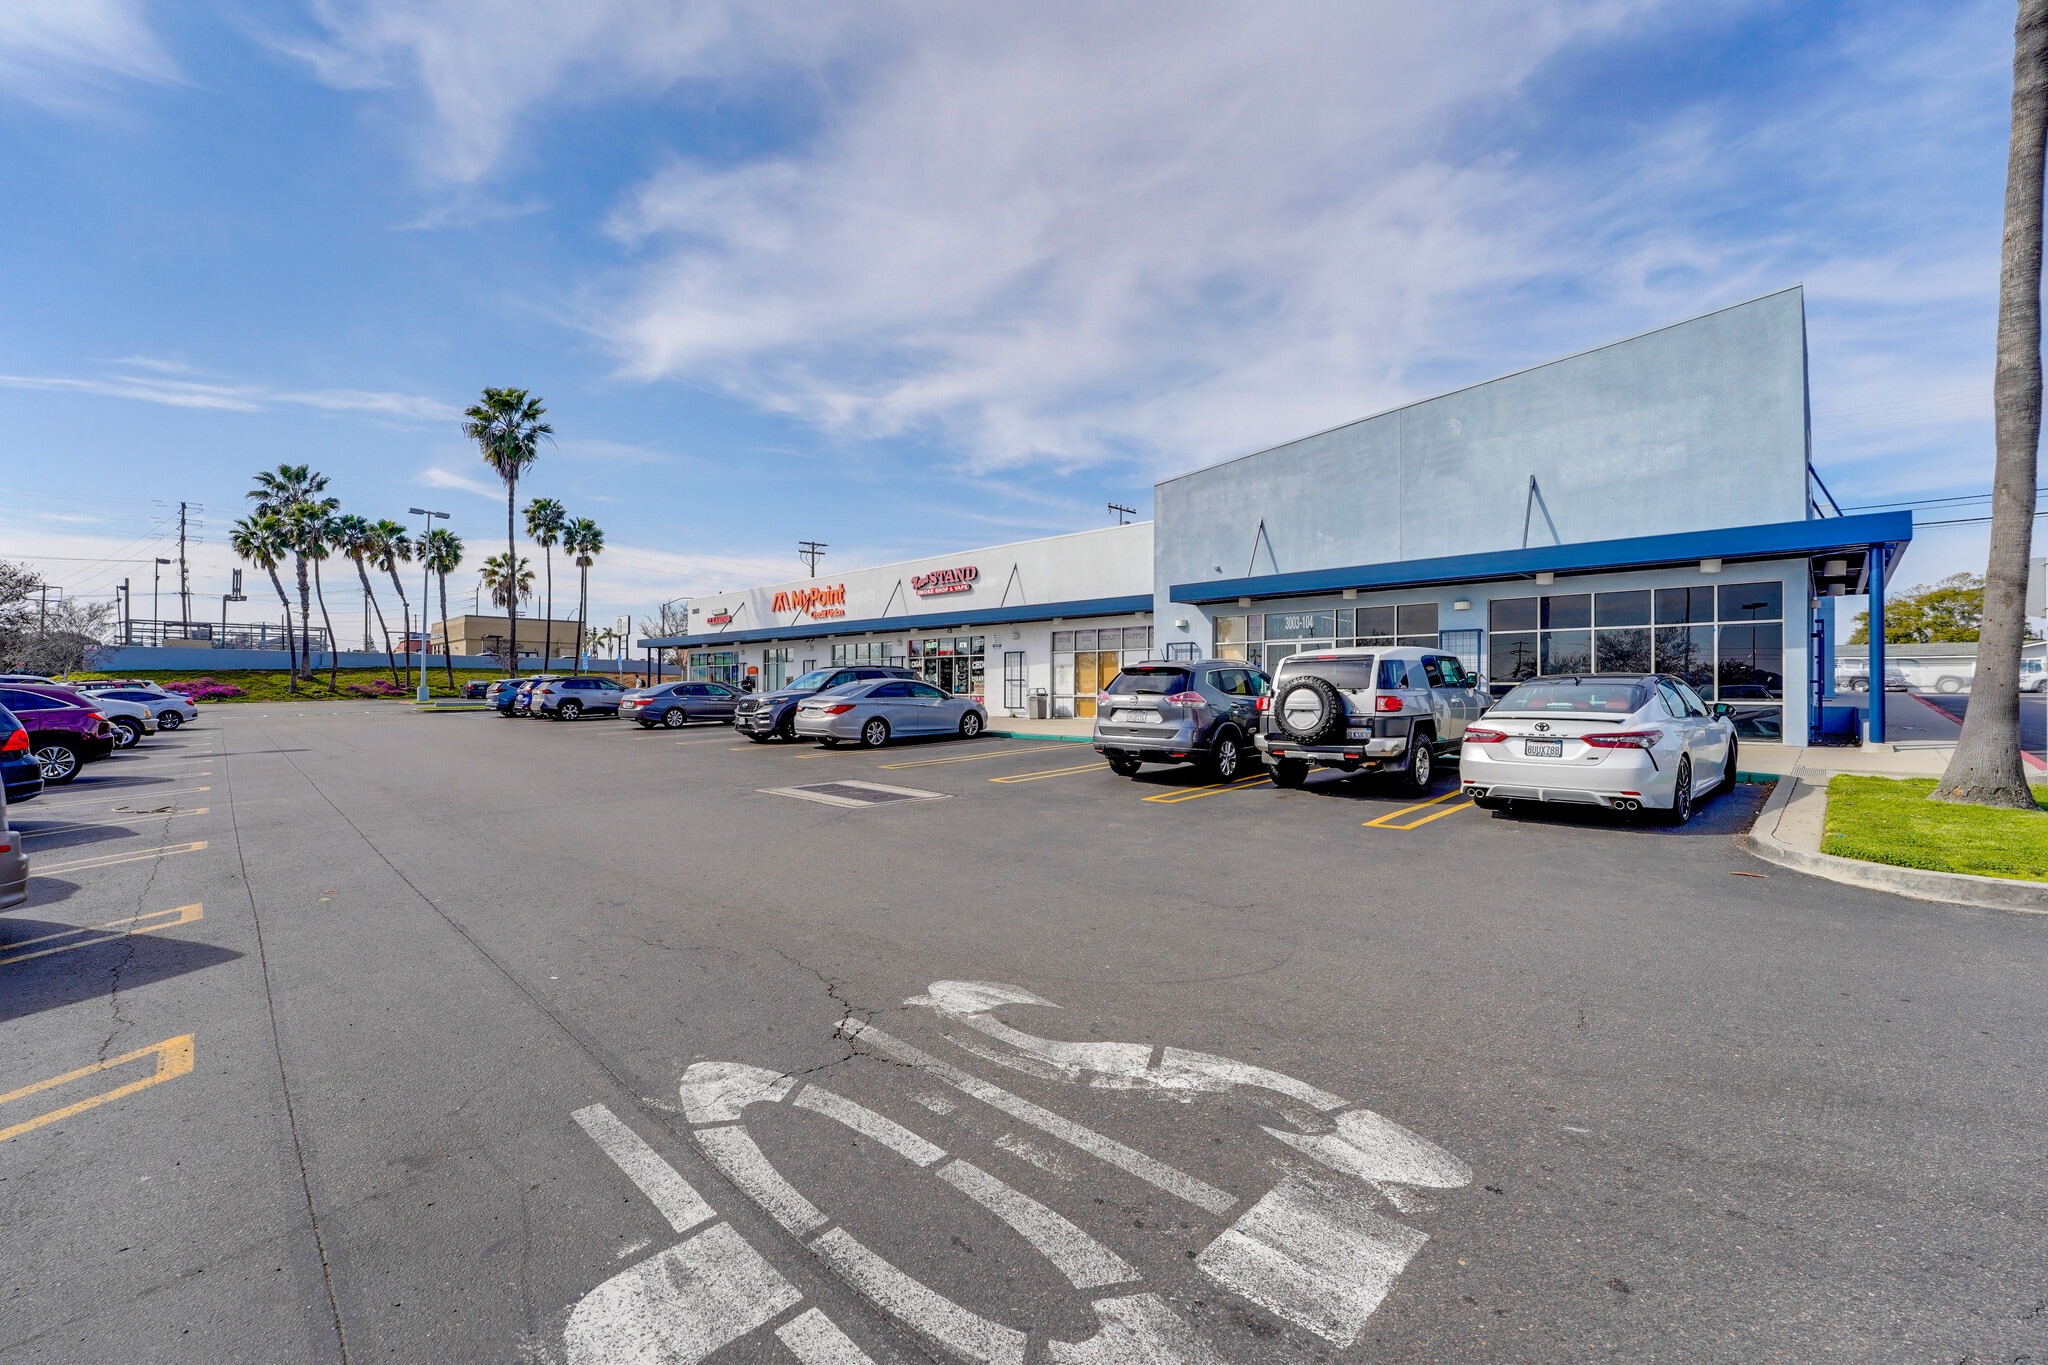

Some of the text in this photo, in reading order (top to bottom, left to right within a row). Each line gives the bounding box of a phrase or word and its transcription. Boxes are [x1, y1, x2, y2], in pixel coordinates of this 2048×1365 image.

[929, 566, 978, 585] STAND
[792, 583, 846, 613] MyPoint
[934, 586, 948, 594] SHOP
[1284, 615, 1313, 630] 3003-104
